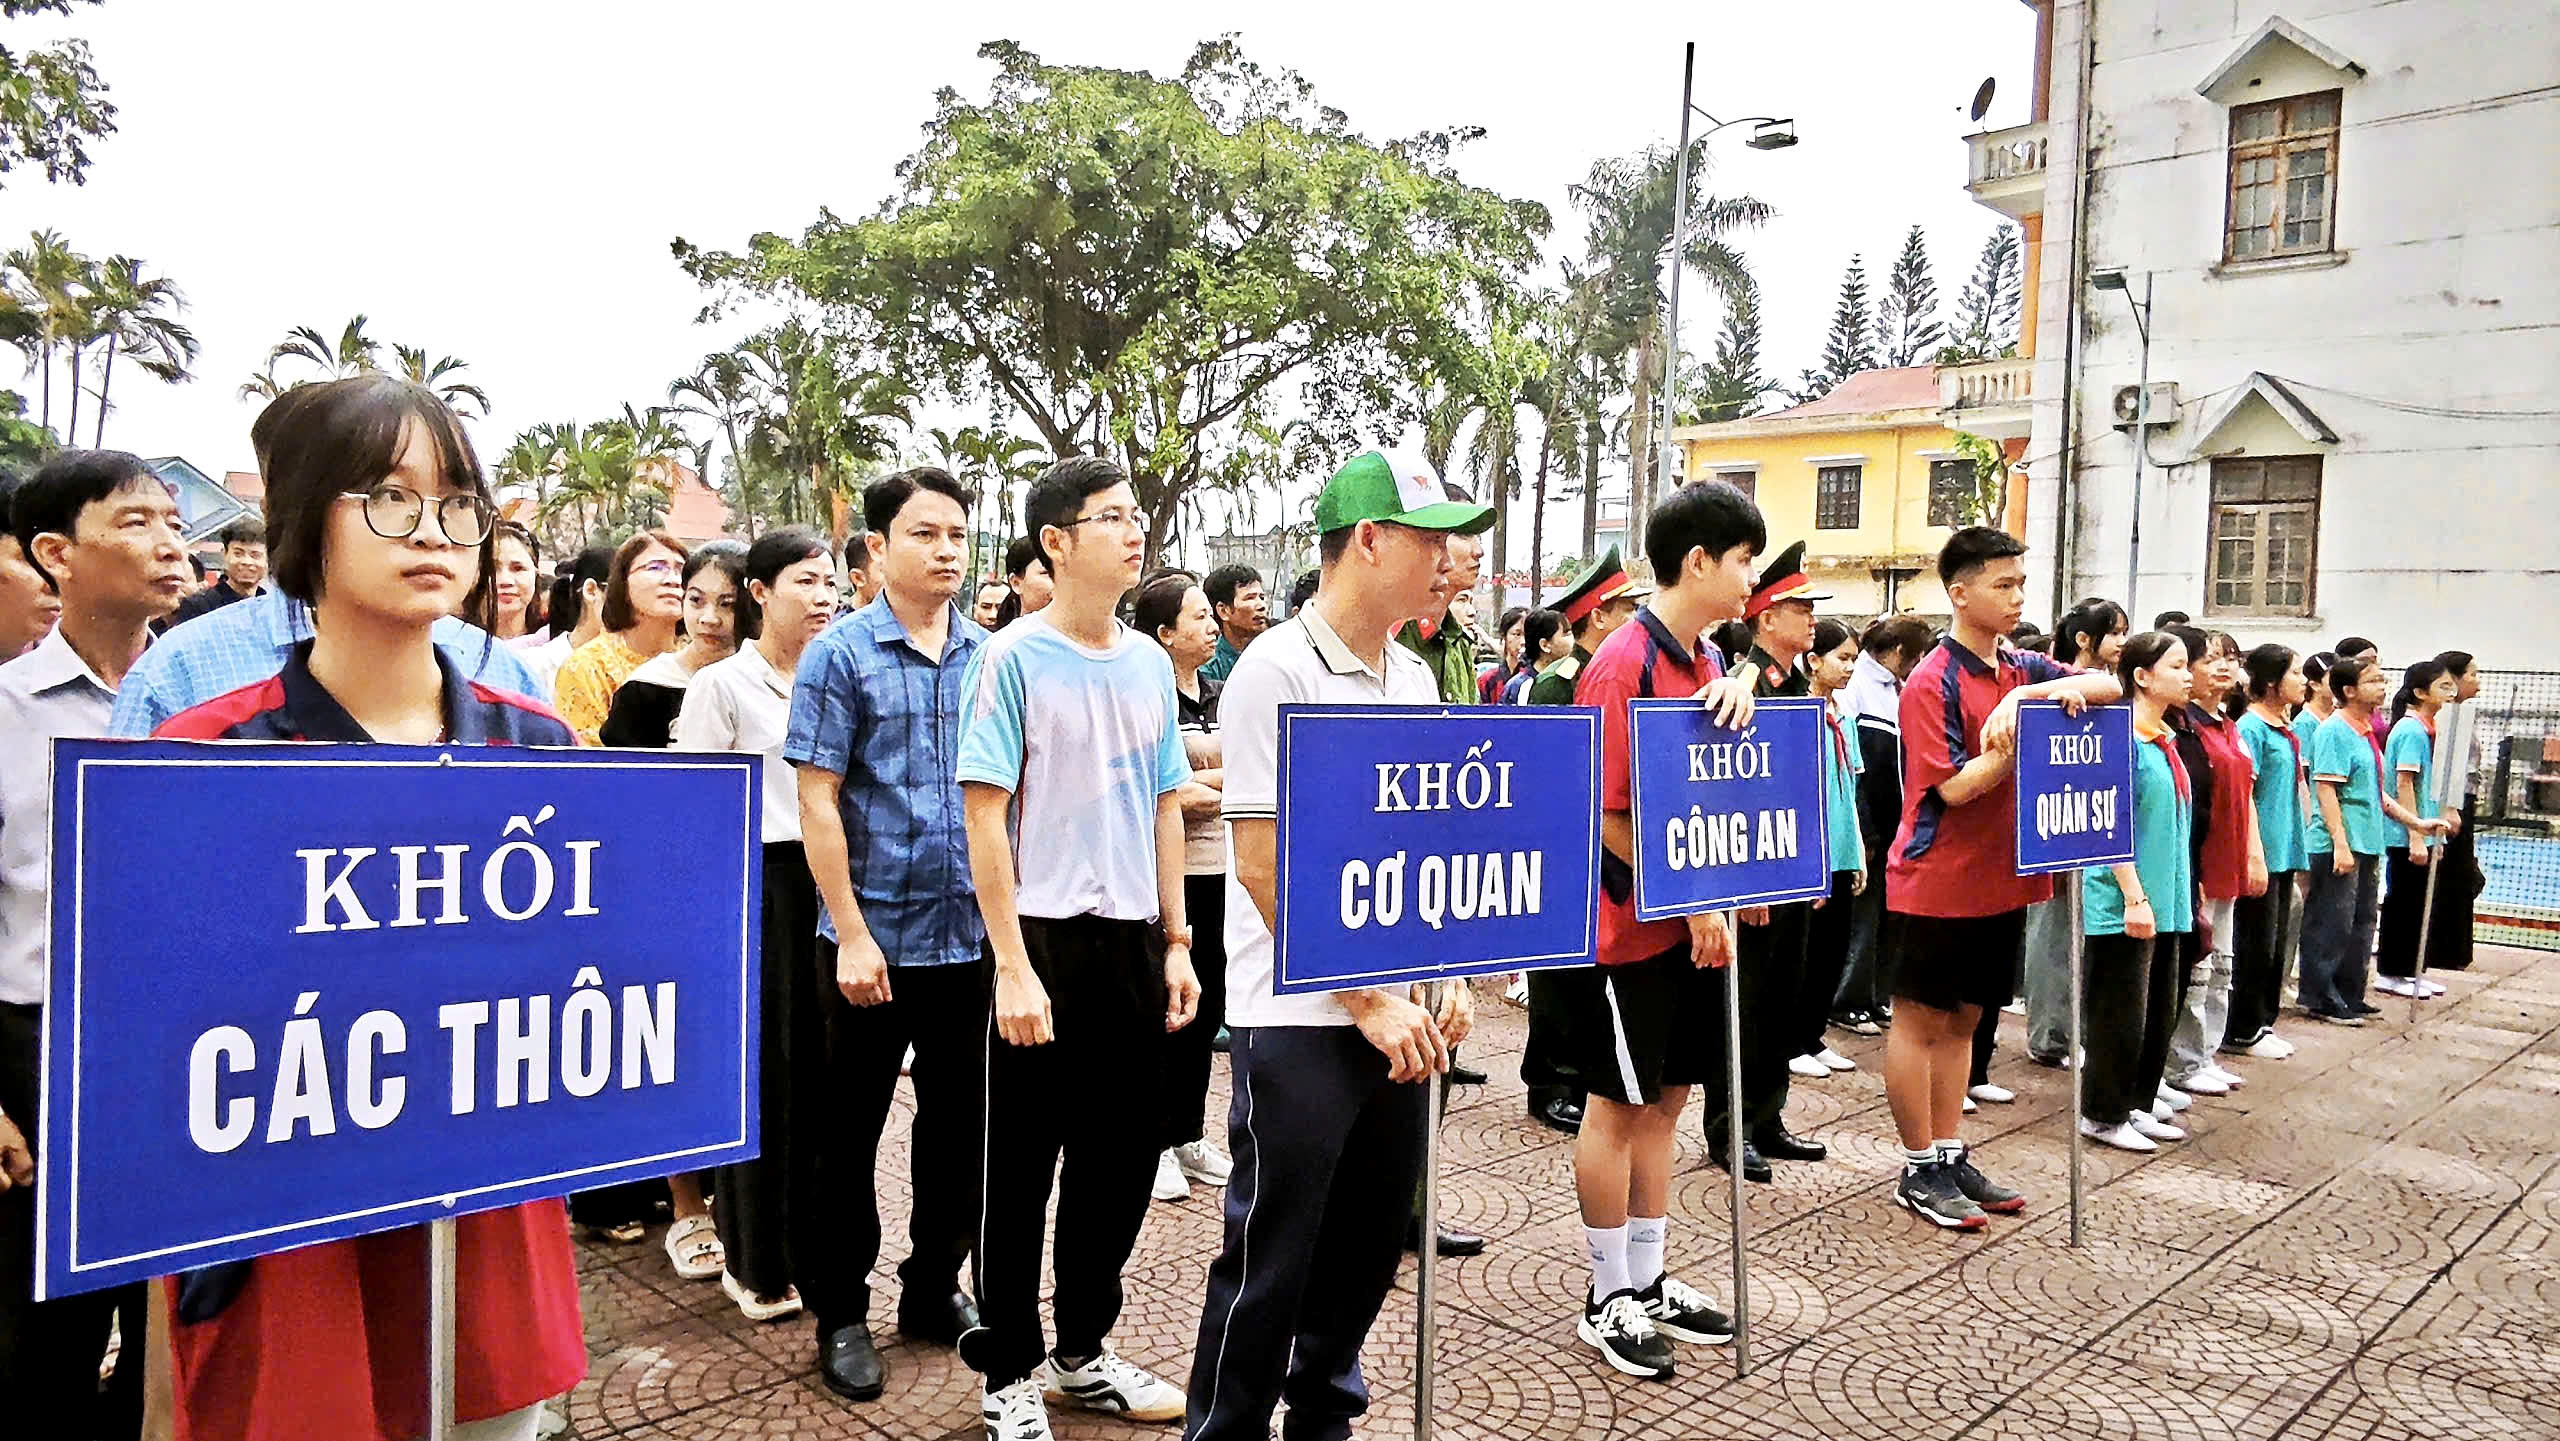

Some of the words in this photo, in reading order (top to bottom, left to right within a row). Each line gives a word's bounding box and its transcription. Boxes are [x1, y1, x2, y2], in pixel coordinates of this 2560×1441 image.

[1374, 739, 1514, 812] KHỐI
[1687, 726, 1772, 781] KHỐI
[2049, 722, 2103, 765] KHỐI
[1667, 805, 1749, 871] CÔNG
[1756, 808, 1798, 861] AN
[2036, 783, 2088, 841] QUÂN
[2092, 784, 2118, 840] SỰ
[296, 804, 601, 933] KHỐI
[1341, 850, 1406, 930] CƠ
[1418, 850, 1542, 930] QUAN
[188, 991, 407, 1154] CÁC
[439, 966, 676, 1115] THÔN
